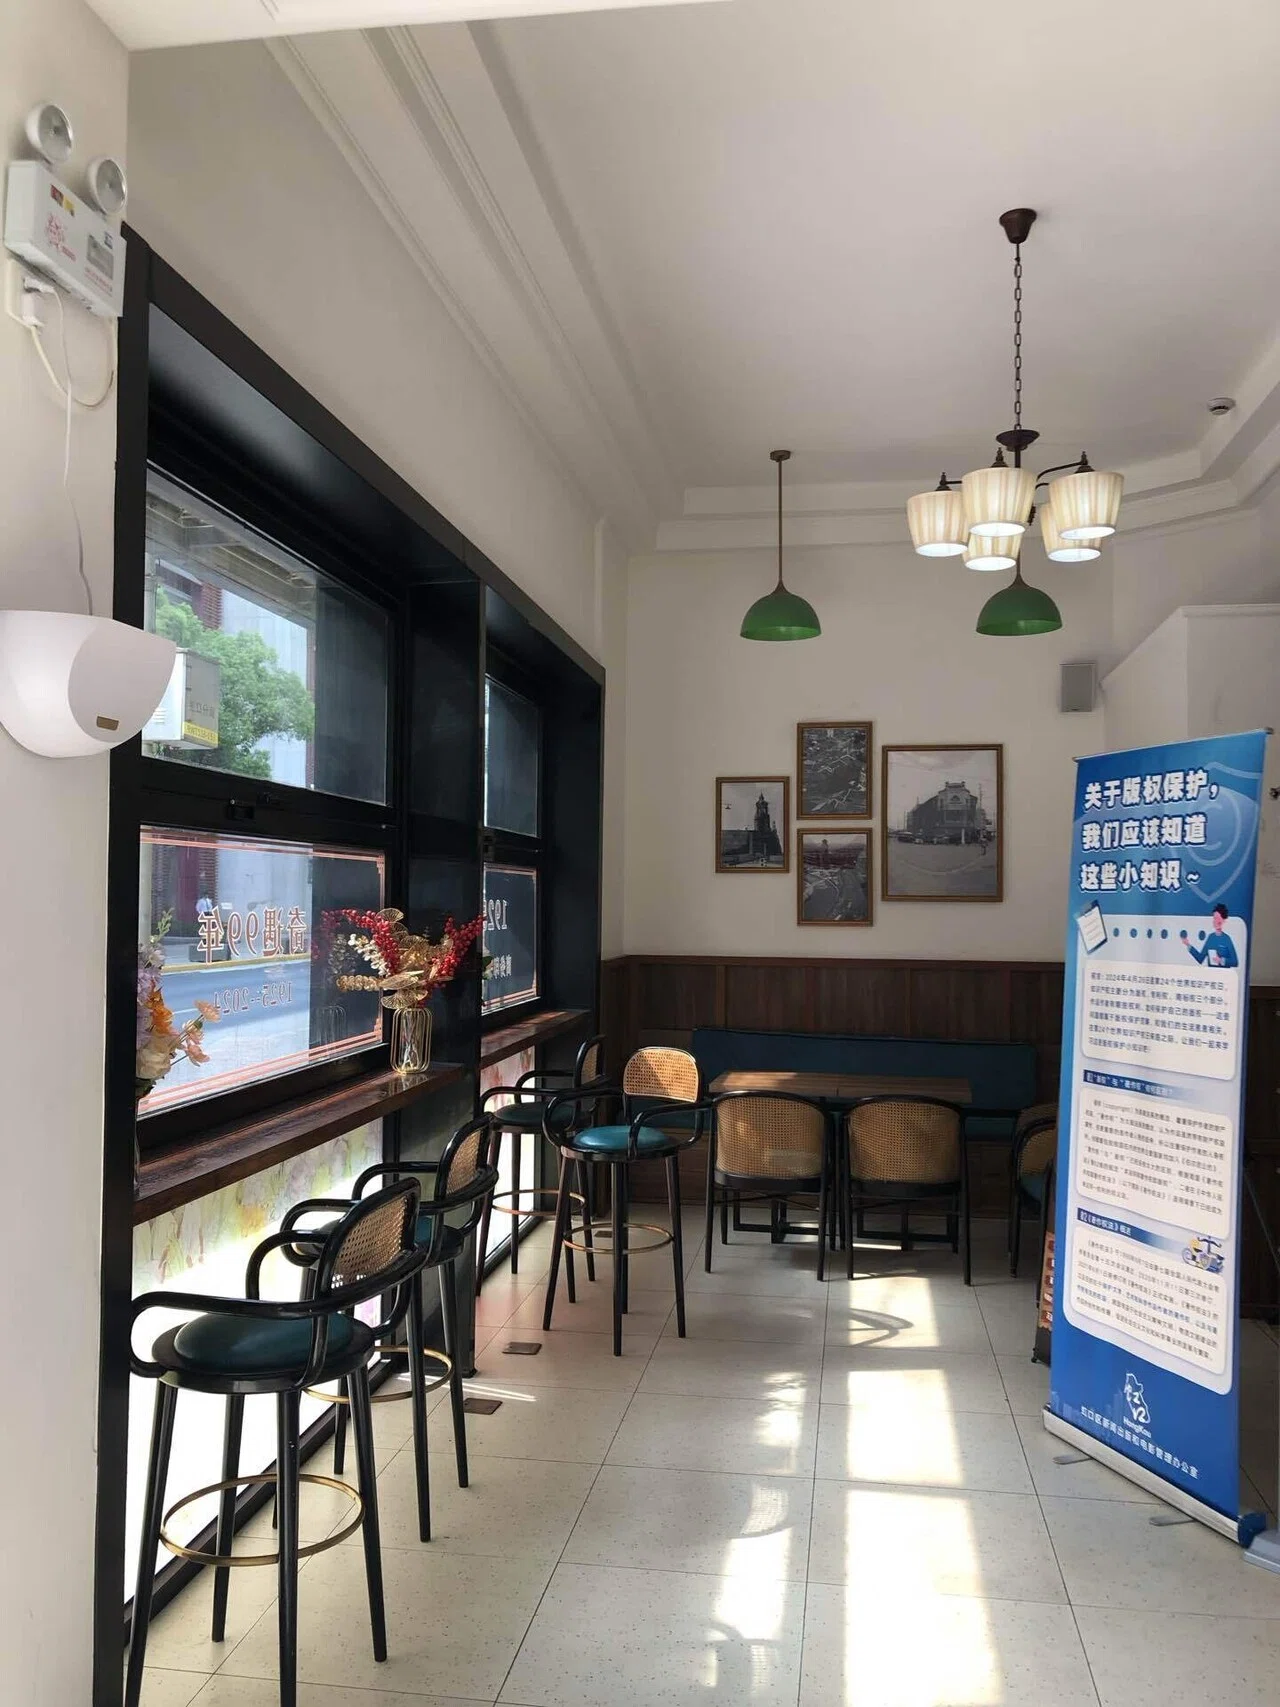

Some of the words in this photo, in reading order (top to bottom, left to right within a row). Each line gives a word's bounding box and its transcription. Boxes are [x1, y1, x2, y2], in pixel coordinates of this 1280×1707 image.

[1084, 768, 1220, 810] 关于版权保护，
[1081, 812, 1208, 852] 我们应该知道
[1081, 1405, 1198, 1480] 虹口区新闻出版和电影管理办公室
